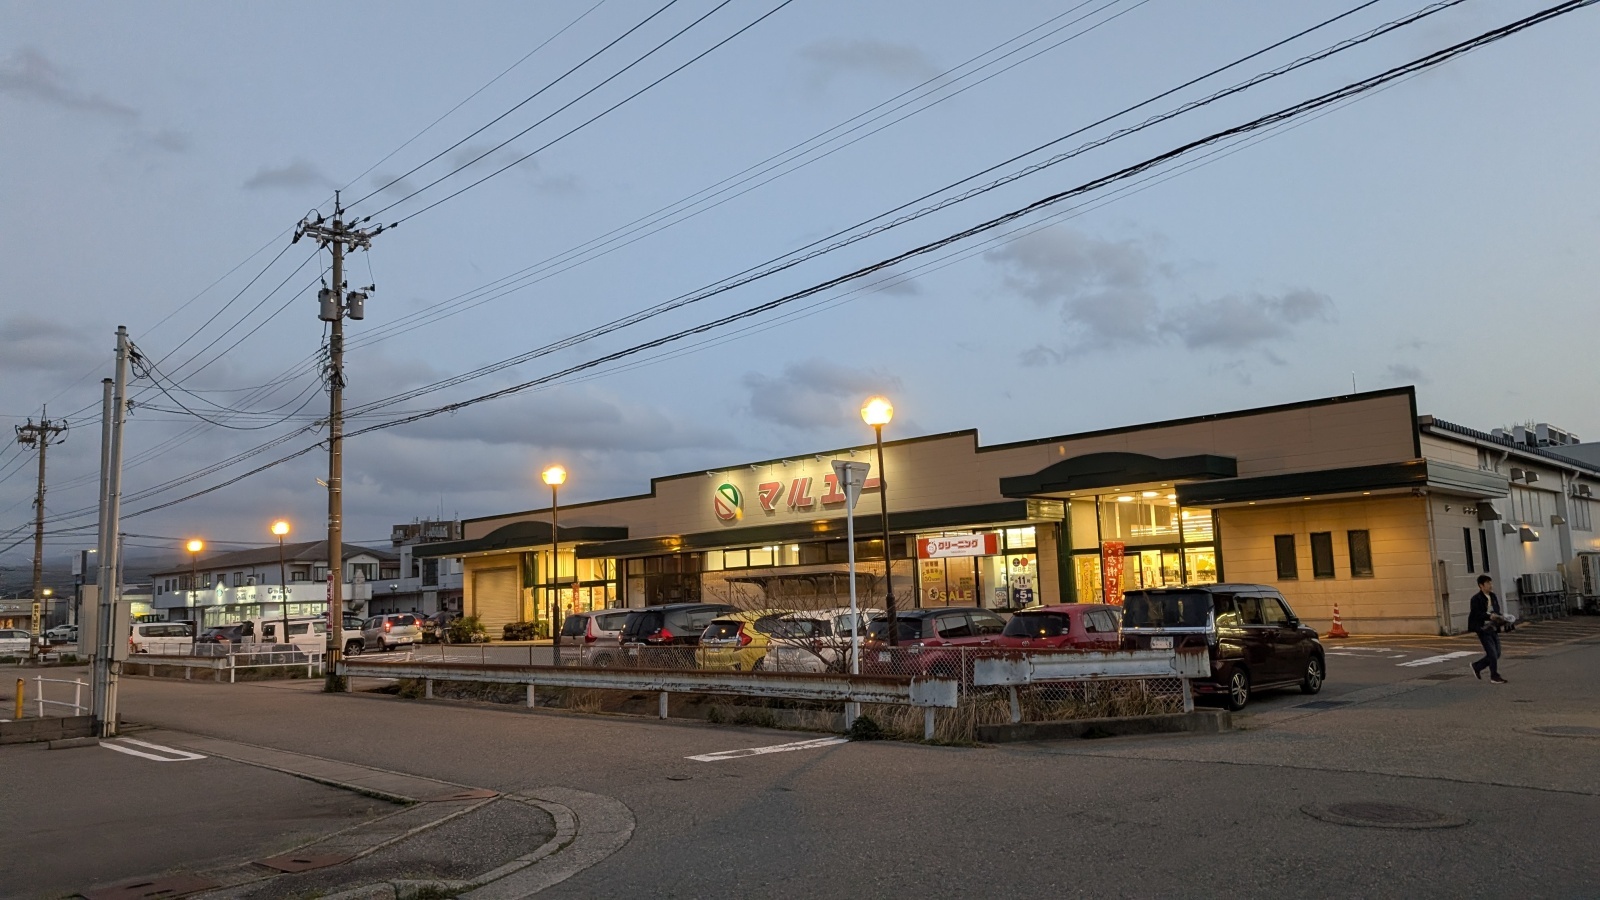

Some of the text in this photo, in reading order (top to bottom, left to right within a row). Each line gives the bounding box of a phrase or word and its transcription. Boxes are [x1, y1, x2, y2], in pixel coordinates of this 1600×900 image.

[758, 473, 883, 510] マルエー
[938, 540, 978, 550] クリーニング
[1107, 555, 1118, 603] 感謝フェア
[939, 590, 973, 602] SALE
